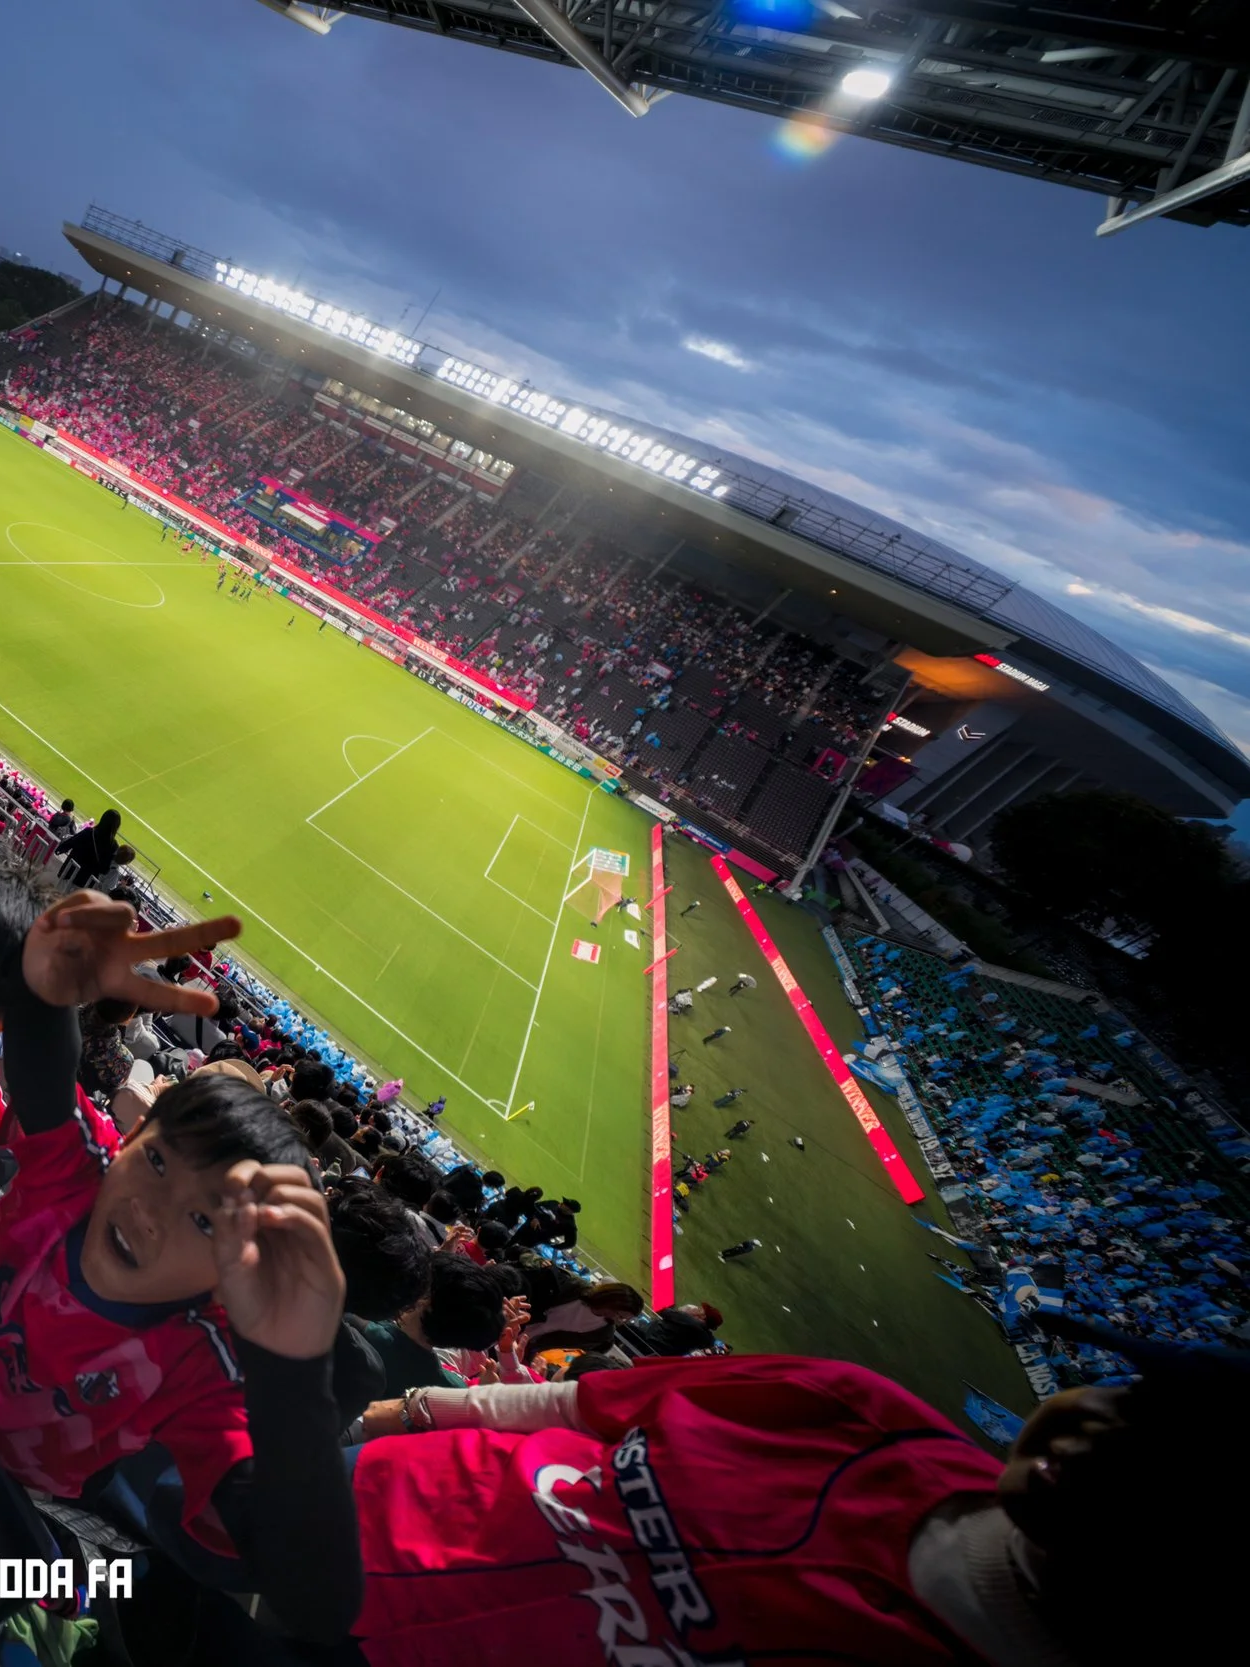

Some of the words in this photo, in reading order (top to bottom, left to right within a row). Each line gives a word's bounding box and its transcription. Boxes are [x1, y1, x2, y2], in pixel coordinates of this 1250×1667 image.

[418, 670, 447, 690] いちご
[996, 663, 1030, 682] STADIUM
[892, 716, 931, 737] STADIUM
[839, 1076, 881, 1134] WINNER
[653, 1101, 670, 1165] WINNER
